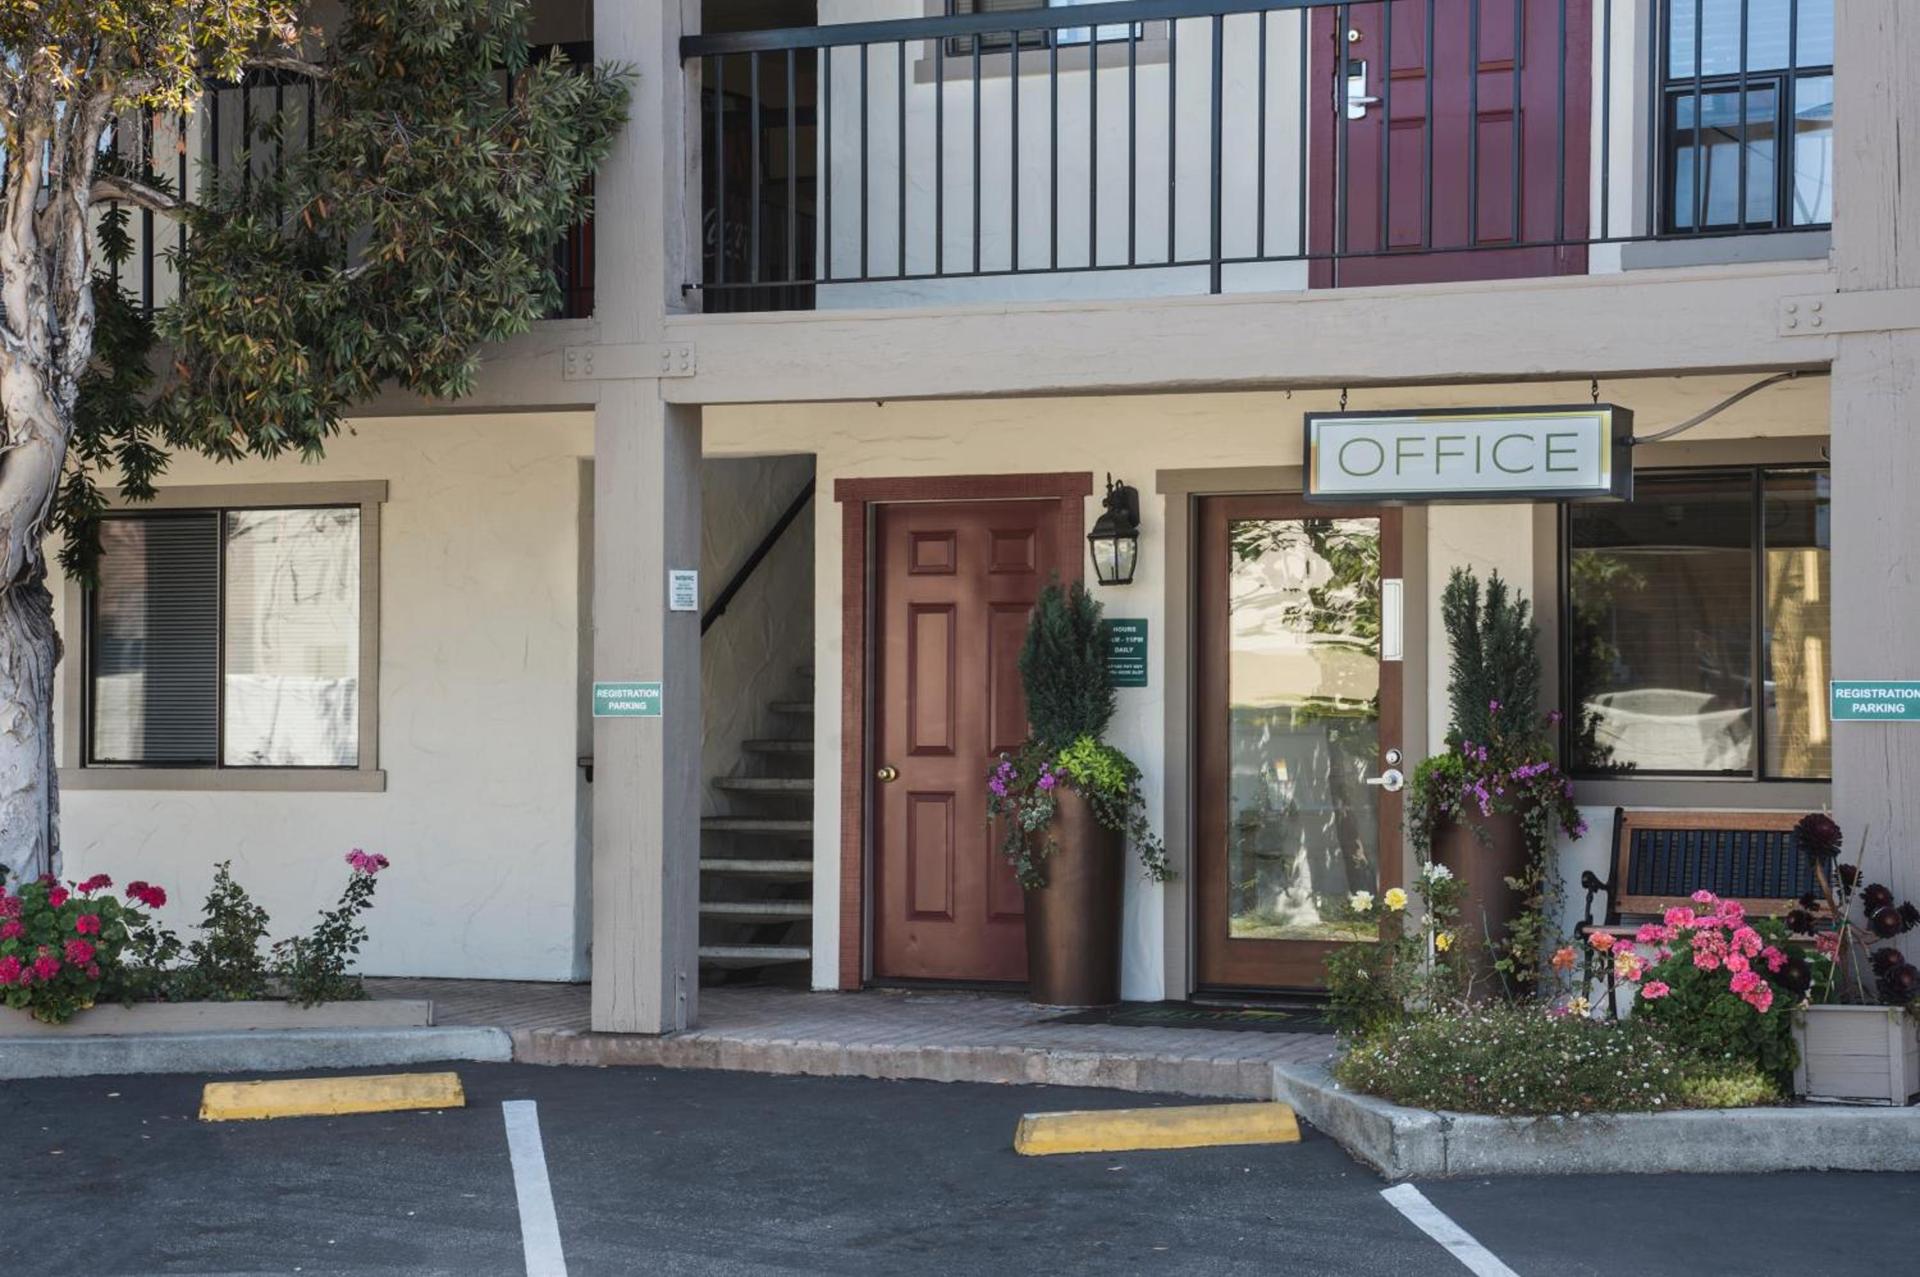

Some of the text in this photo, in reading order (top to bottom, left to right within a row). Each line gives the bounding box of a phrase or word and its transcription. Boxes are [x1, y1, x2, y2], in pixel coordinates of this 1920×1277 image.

[1339, 433, 1579, 476] OFFICE
[597, 689, 659, 698] REGISTRATION
[1835, 688, 1920, 698] REGISTRATION
[608, 701, 647, 710] PARKING
[1852, 703, 1905, 713] PARKING
